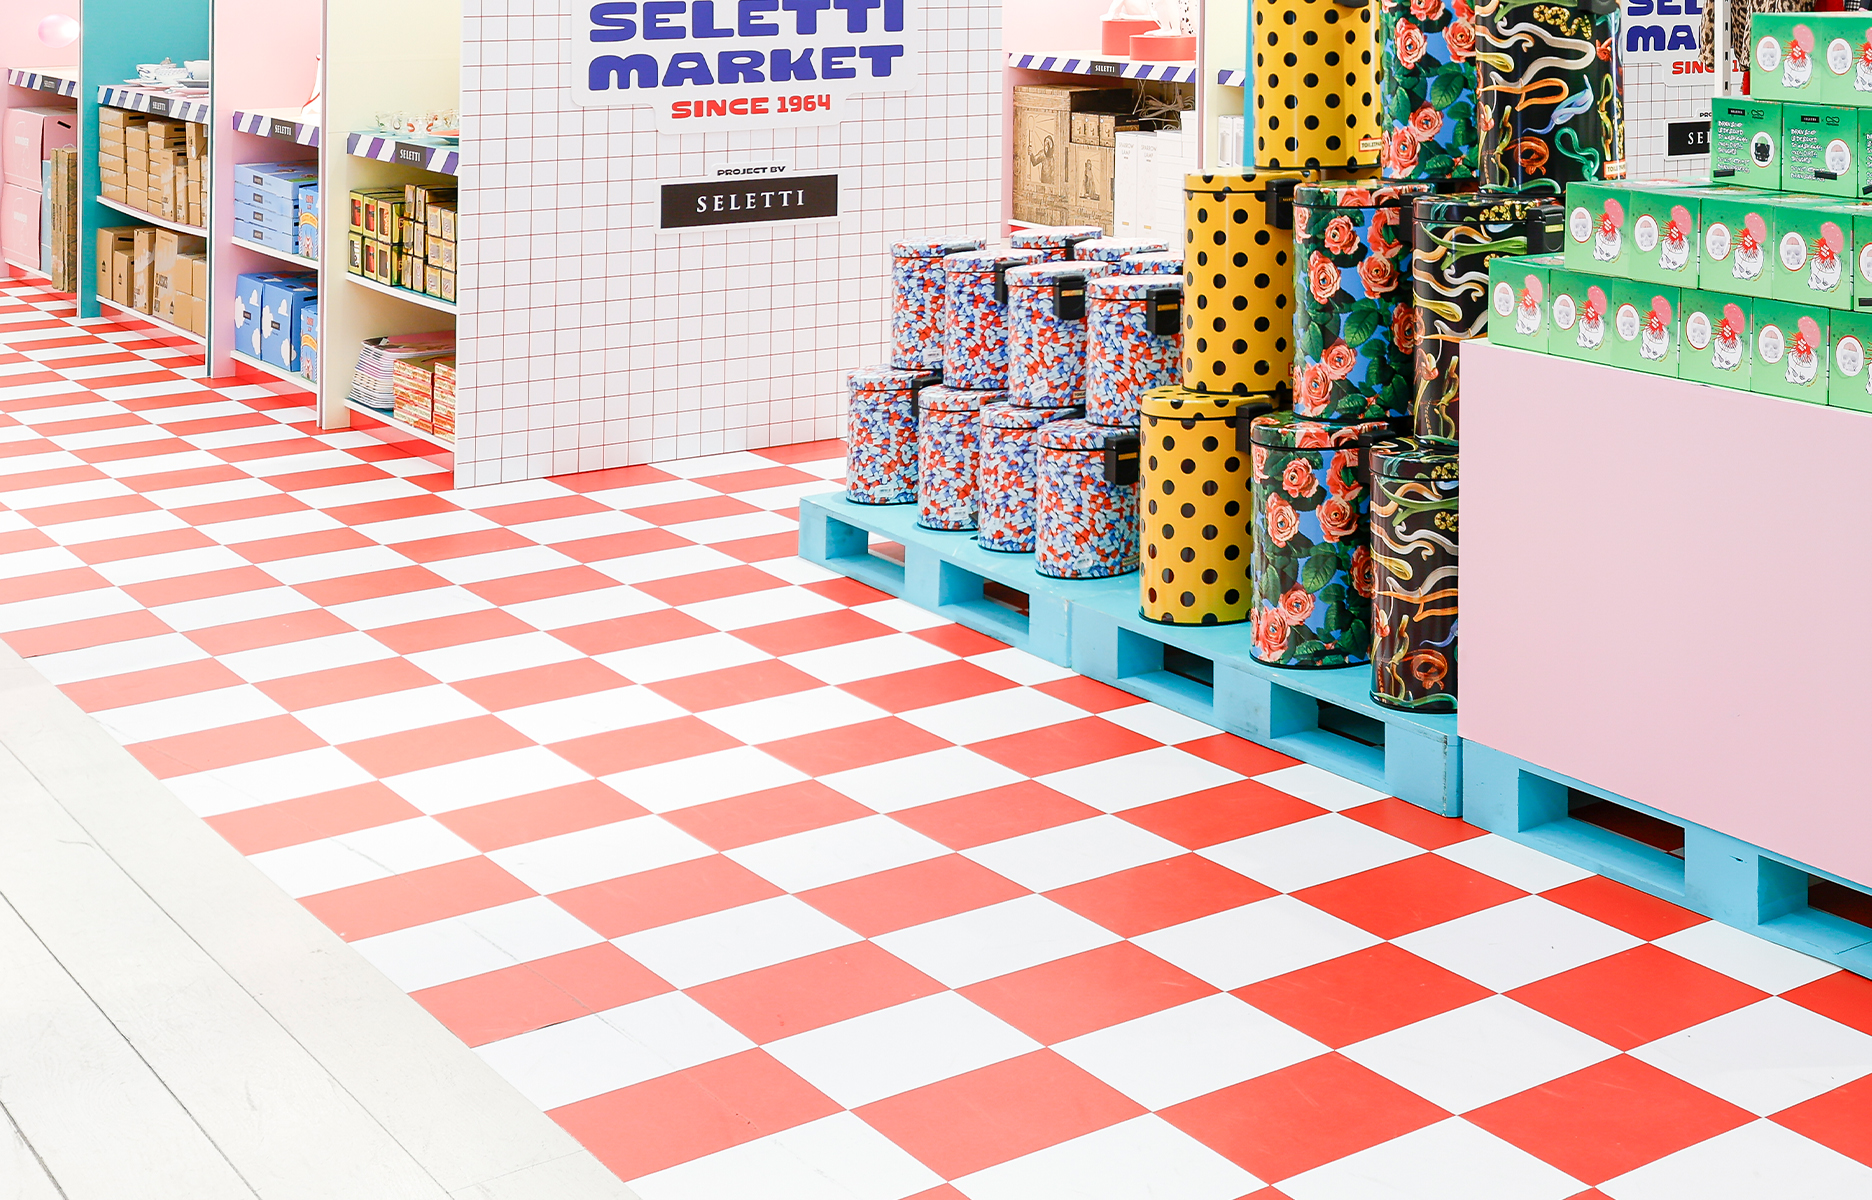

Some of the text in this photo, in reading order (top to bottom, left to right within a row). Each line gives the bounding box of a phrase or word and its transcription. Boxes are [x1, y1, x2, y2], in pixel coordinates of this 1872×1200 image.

[588, 44, 905, 92] MARKET
[671, 93, 832, 119] SINCE 1964
[399, 148, 421, 162] SELETTI
[717, 166, 768, 176] PROJECT
[696, 189, 804, 213] SELETTI
